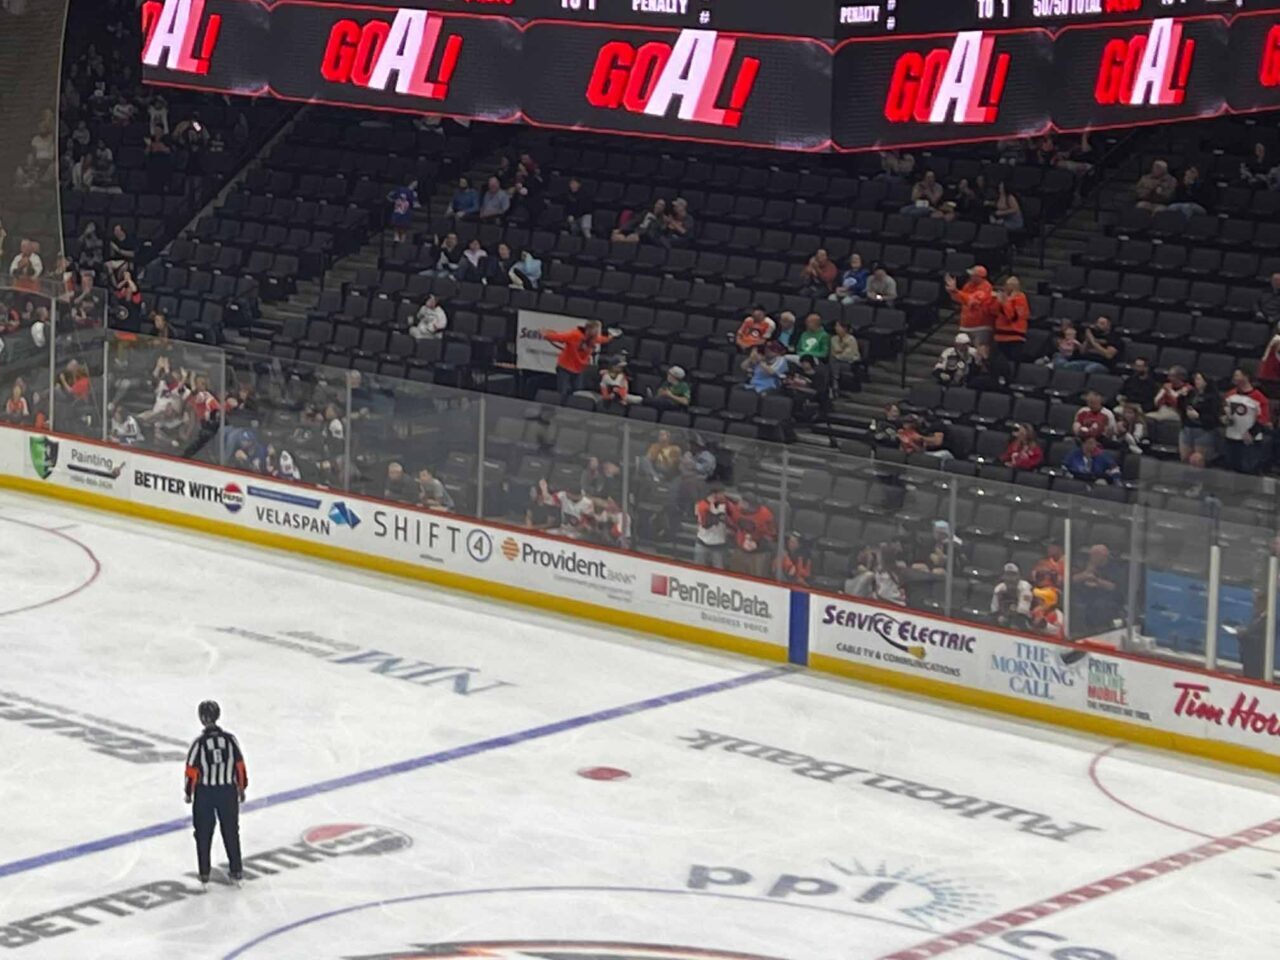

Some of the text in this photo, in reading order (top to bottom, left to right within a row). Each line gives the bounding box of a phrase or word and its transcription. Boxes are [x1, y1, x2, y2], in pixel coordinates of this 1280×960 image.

[699, 10, 711, 24] #
[840, 4, 881, 24] PENALTY
[886, 16, 897, 30] #
[321, 8, 464, 101] GOAL!
[1094, 17, 1196, 105] GOAL!
[585, 28, 761, 128] GOAL!
[884, 30, 1012, 124] GOAL!
[71, 448, 114, 470] Painting
[134, 470, 186, 497] BETTER
[189, 481, 223, 504] WITH
[256, 505, 331, 536] VELASPAN
[373, 509, 485, 556] SHIFT 4
[522, 542, 607, 580] Provident
[822, 604, 977, 654] SERVICE ELECTRIC
[836, 642, 961, 677] CABLE TV & COMMUNICATIONS
[1015, 641, 1050, 663] THE
[991, 654, 1074, 687] MORNING
[1009, 676, 1055, 700] CALL
[1173, 682, 1225, 726] Tim
[677, 727, 1104, 842] Fulton Bank
[687, 862, 904, 905] ppl
